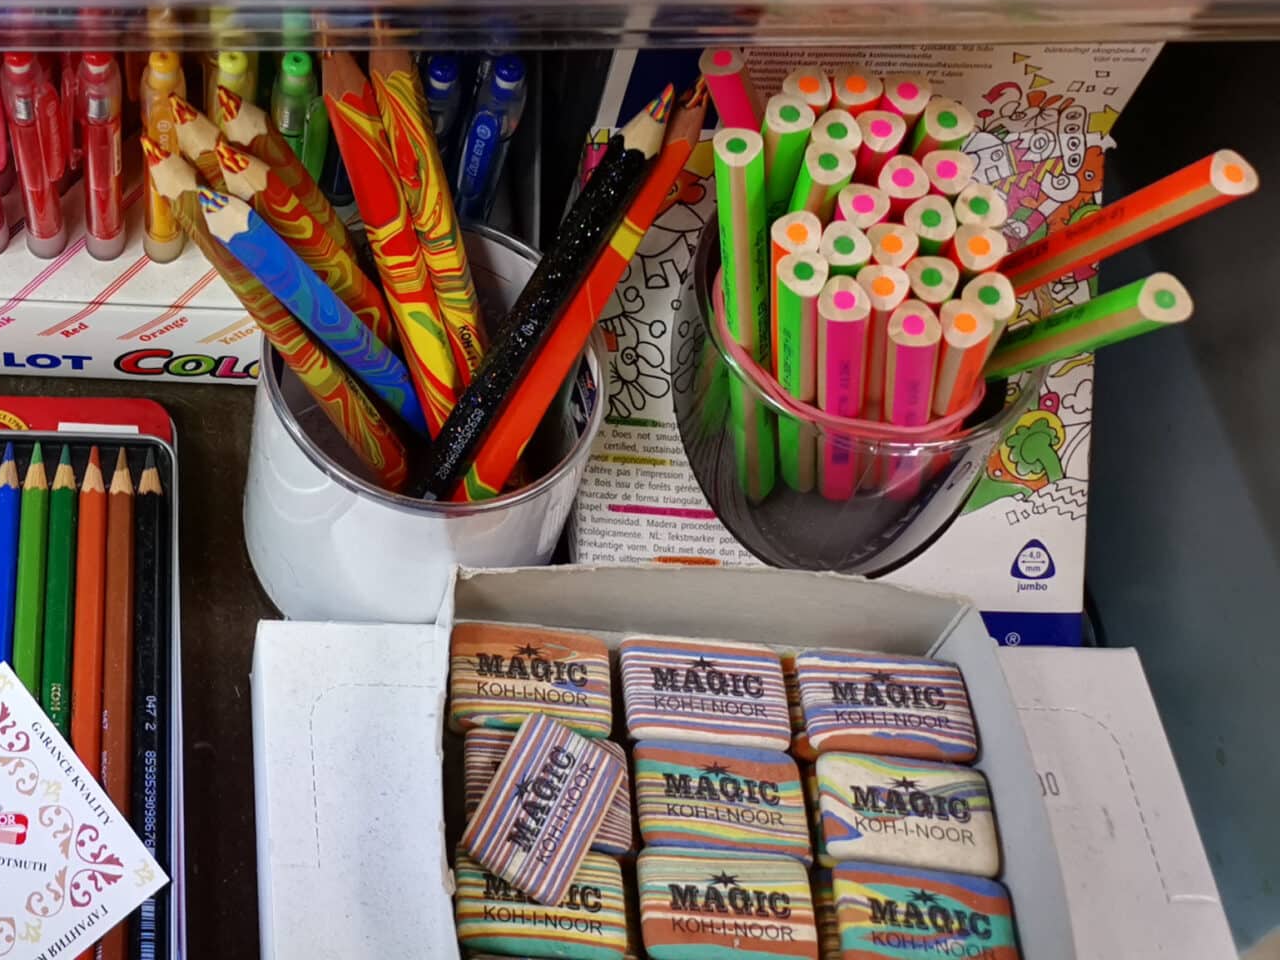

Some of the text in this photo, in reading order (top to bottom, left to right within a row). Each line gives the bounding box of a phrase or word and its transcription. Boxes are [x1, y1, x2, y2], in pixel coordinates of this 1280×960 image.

[61, 322, 89, 339] Red
[139, 315, 189, 343] Orange
[612, 429, 651, 439] Does not
[603, 442, 637, 454] certified,
[594, 478, 612, 489] Bois
[634, 481, 645, 490] de
[616, 468, 684, 481] pas l'impression
[579, 490, 703, 507] marcador de forma triangular
[590, 515, 677, 530] luminosidad. Madera
[578, 539, 624, 552] driekantige
[653, 543, 675, 553] Drukt
[678, 545, 694, 555] niet
[697, 546, 716, 556] door
[668, 533, 716, 544] Tekstmarker
[593, 553, 615, 563] prints
[1017, 581, 1048, 593] jumbo
[476, 653, 588, 687] MAGIC
[651, 667, 764, 698] MAGIC
[476, 681, 589, 708] KOH-I-NOOR
[654, 695, 768, 718] KOH-I-NOOR
[829, 681, 946, 711] MAGIC
[835, 709, 952, 730] KOH-I-NOOR
[29, 720, 114, 827] GARANCE KVALITY
[142, 750, 157, 848] 8593539098676
[508, 745, 577, 853] MAGIC
[663, 773, 781, 806] MAGIC
[537, 762, 597, 867] KOH-I-NOOR
[667, 803, 785, 827] KOH-I-NOOR
[850, 786, 971, 824] MAGIC
[854, 816, 977, 847] KOH-I-NOOR
[669, 884, 792, 919] MAGIC
[483, 905, 603, 936] KOH-I-NOOR
[672, 915, 795, 942] KOH-I-NOOR
[870, 898, 993, 941] MAGIC
